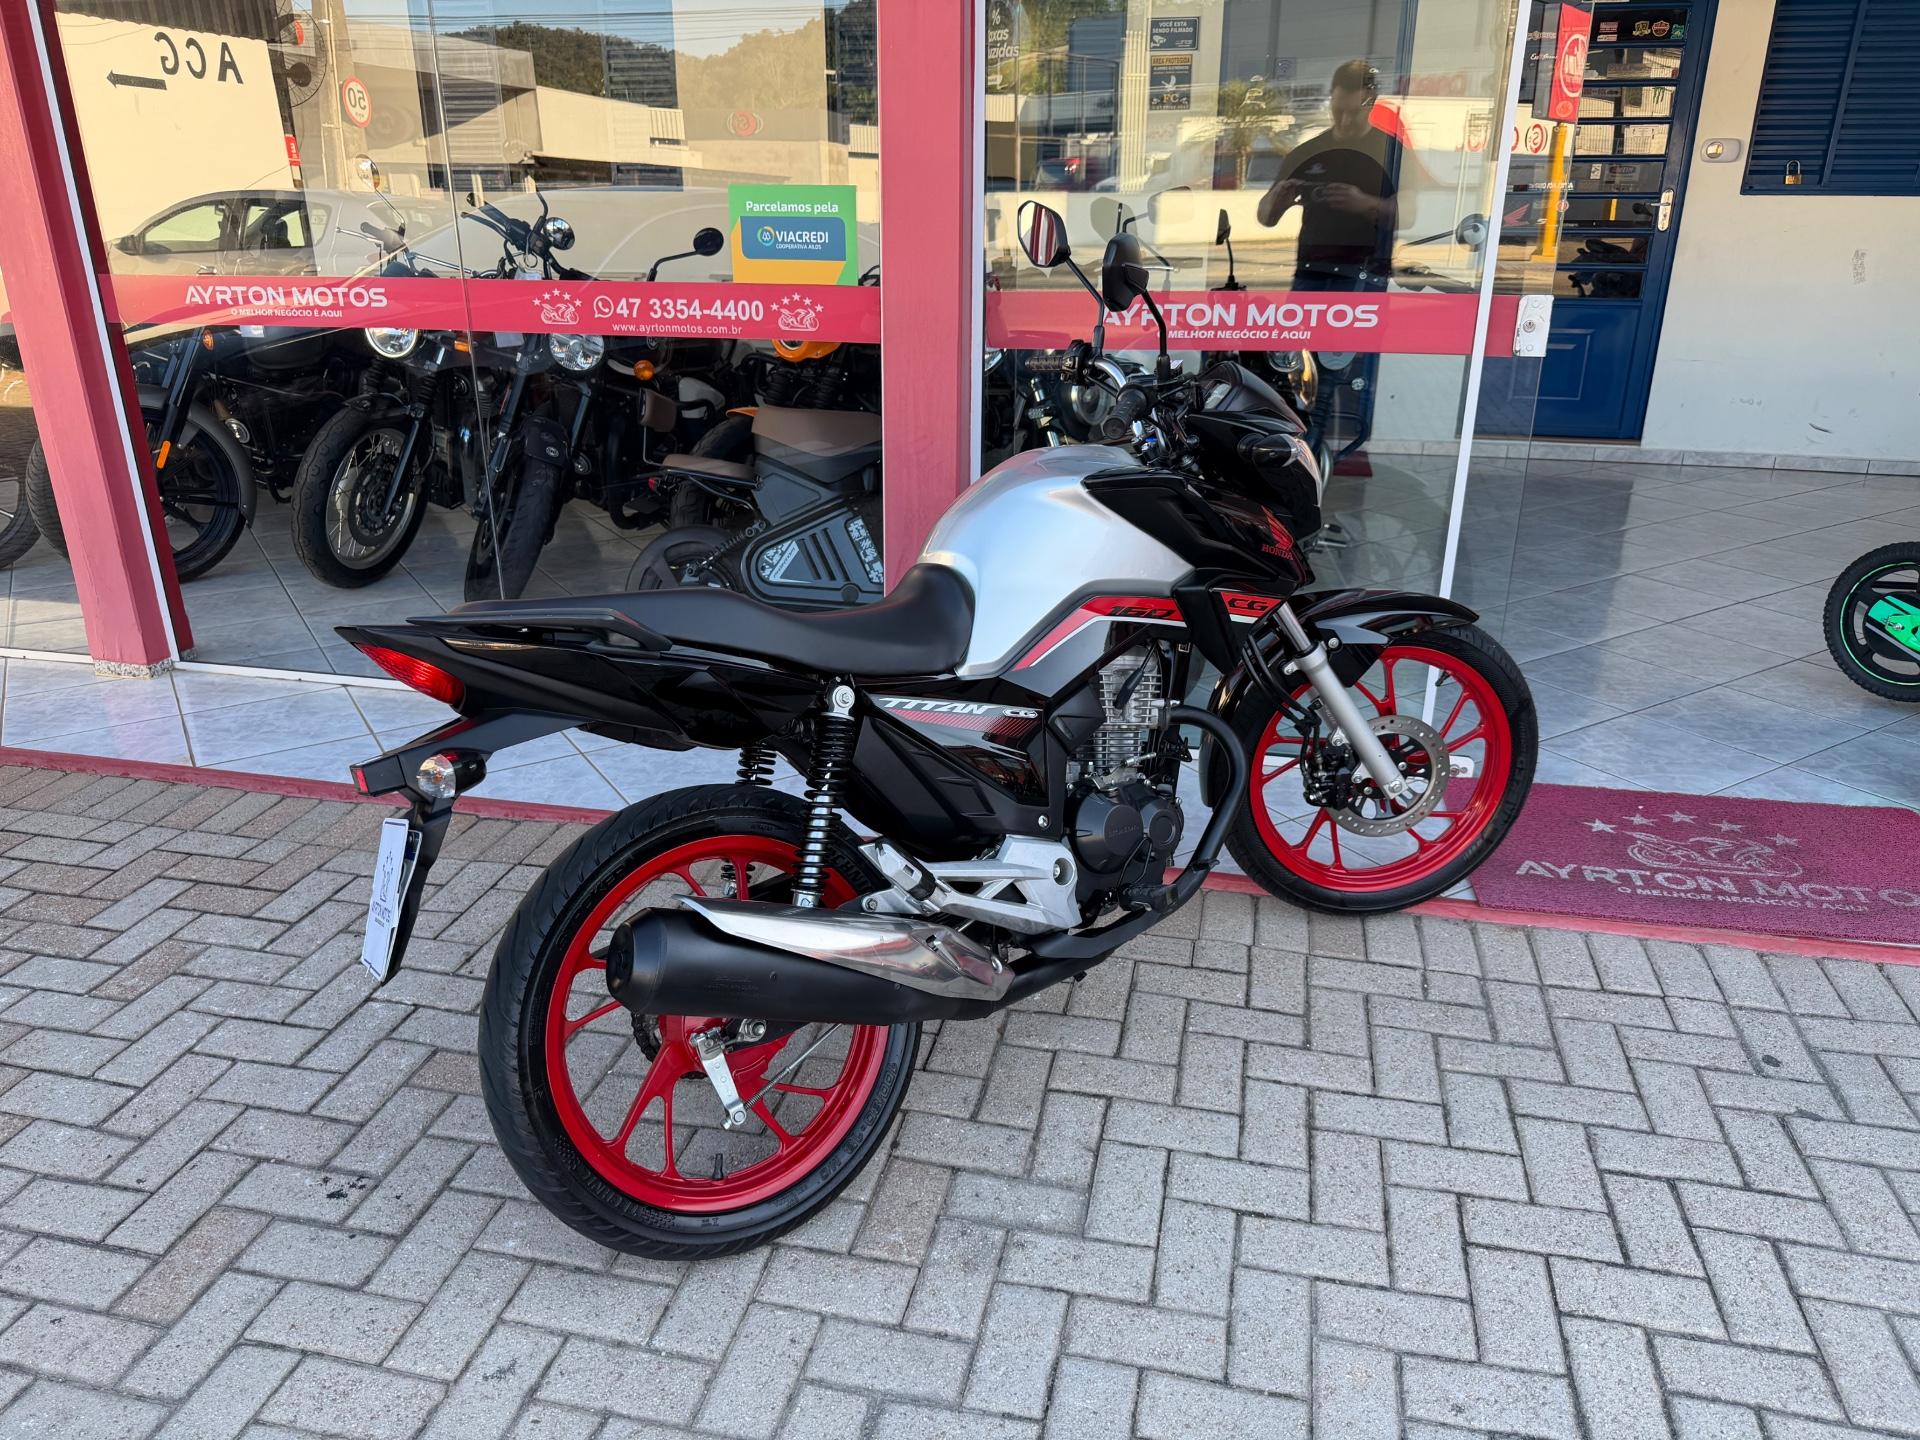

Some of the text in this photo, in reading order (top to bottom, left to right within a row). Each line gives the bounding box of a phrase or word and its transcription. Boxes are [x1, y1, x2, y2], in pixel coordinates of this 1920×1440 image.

[745, 201, 839, 215] Parcelamos pela
[776, 231, 829, 244] VIACREDI
[185, 285, 388, 308] AYRTON MOTOS
[239, 308, 273, 317] MELHOR
[275, 308, 312, 318] NEGÓCIO
[314, 308, 320, 317] É
[321, 310, 343, 318] AQUI
[616, 298, 764, 322] 47 3354-4400
[1246, 303, 1379, 328] MOTOS
[612, 322, 743, 335] www.ayrtonmotos.com.br
[1168, 330, 1214, 339] MELHOR
[1216, 328, 1269, 340] NEGÓCIO
[1272, 328, 1280, 340] É
[1281, 331, 1312, 340] AQUI
[1261, 543, 1294, 561] HONDA
[1229, 598, 1269, 612] CG
[879, 697, 1000, 715] TITAN
[1515, 859, 1738, 894] AYRTON
